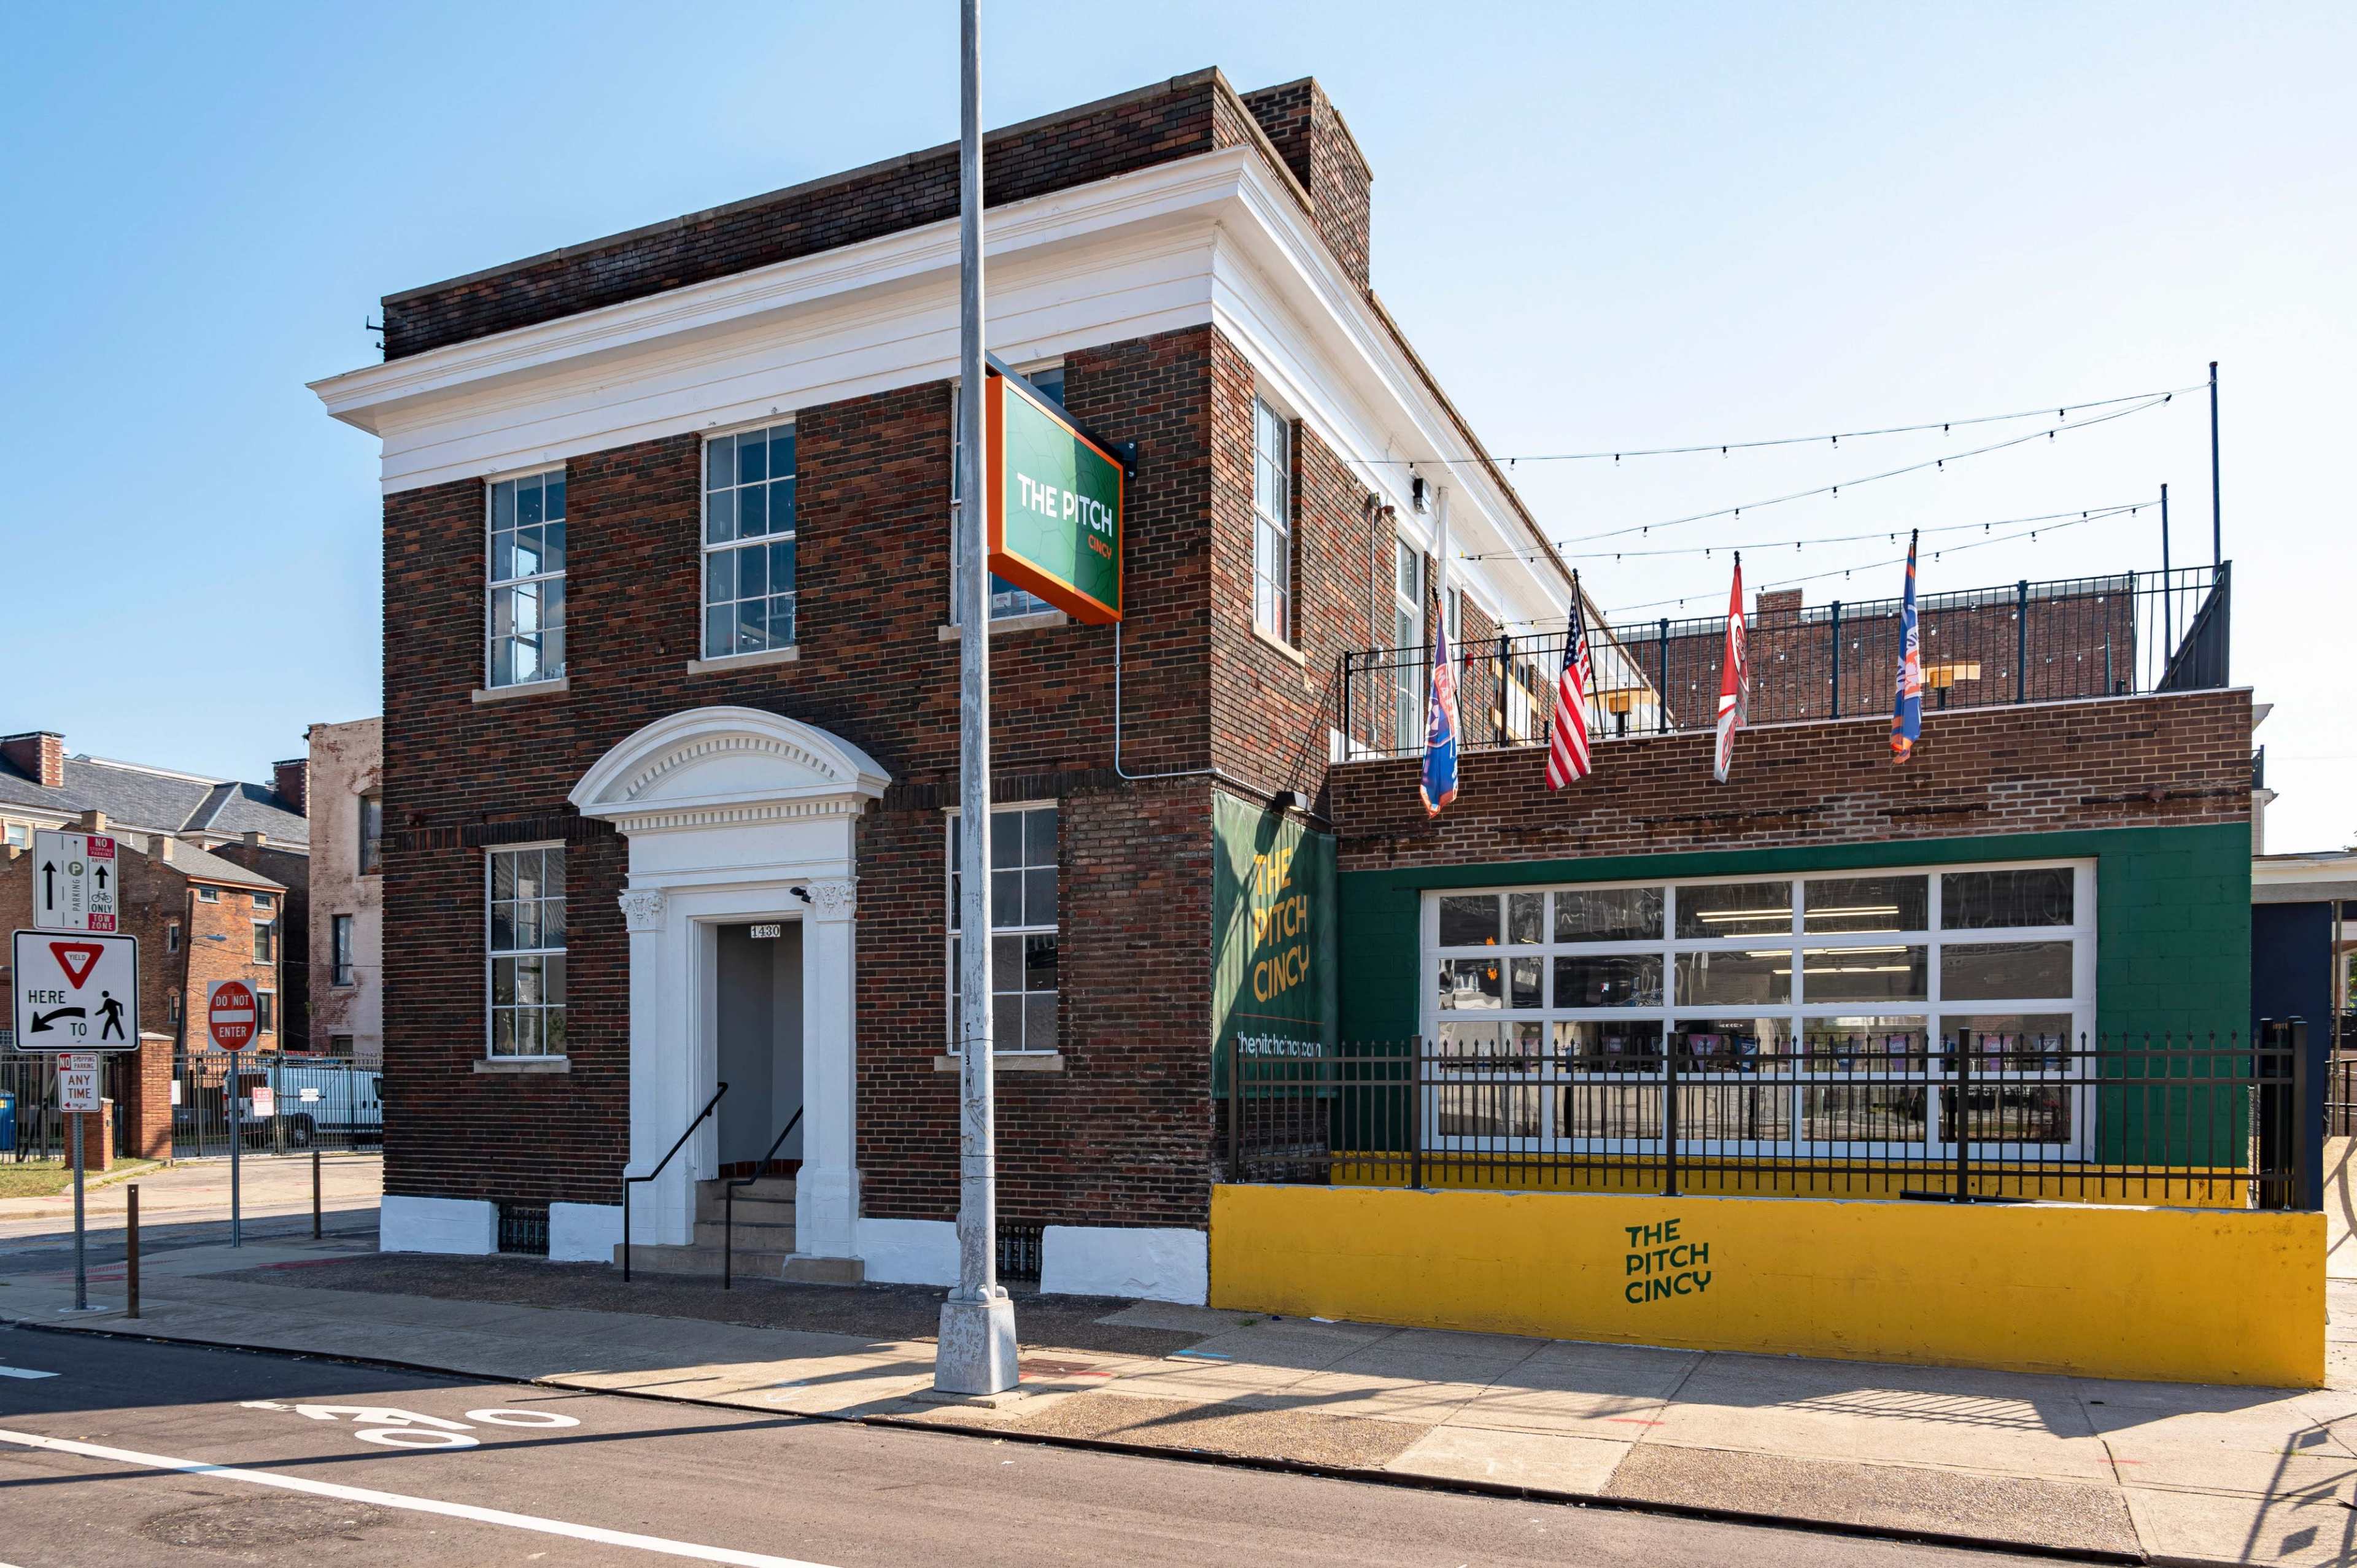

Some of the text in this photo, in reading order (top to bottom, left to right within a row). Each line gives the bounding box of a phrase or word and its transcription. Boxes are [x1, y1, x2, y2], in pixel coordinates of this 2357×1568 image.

[1017, 472, 1112, 537] THE PITCH
[1088, 533, 1112, 560] CINCY
[95, 838, 107, 848] NO
[72, 863, 81, 875] P
[1253, 846, 1291, 895] THE
[72, 879, 81, 911] PARKING
[91, 903, 112, 913] ONLY
[1254, 894, 1308, 950] PITCH
[752, 925, 780, 937] 1430
[1253, 944, 1310, 1003] CINCY
[28, 989, 66, 1004] HERE
[215, 995, 250, 1006] DO NOT
[70, 1022, 87, 1037] TO
[219, 1026, 247, 1038] ENTER
[60, 1057, 70, 1068] NO
[68, 1075, 90, 1086] ANY
[67, 1088, 92, 1099] TIME
[1625, 1218, 1681, 1248] THE
[1626, 1242, 1709, 1276] PITCH
[1625, 1270, 1711, 1304] CINCY
